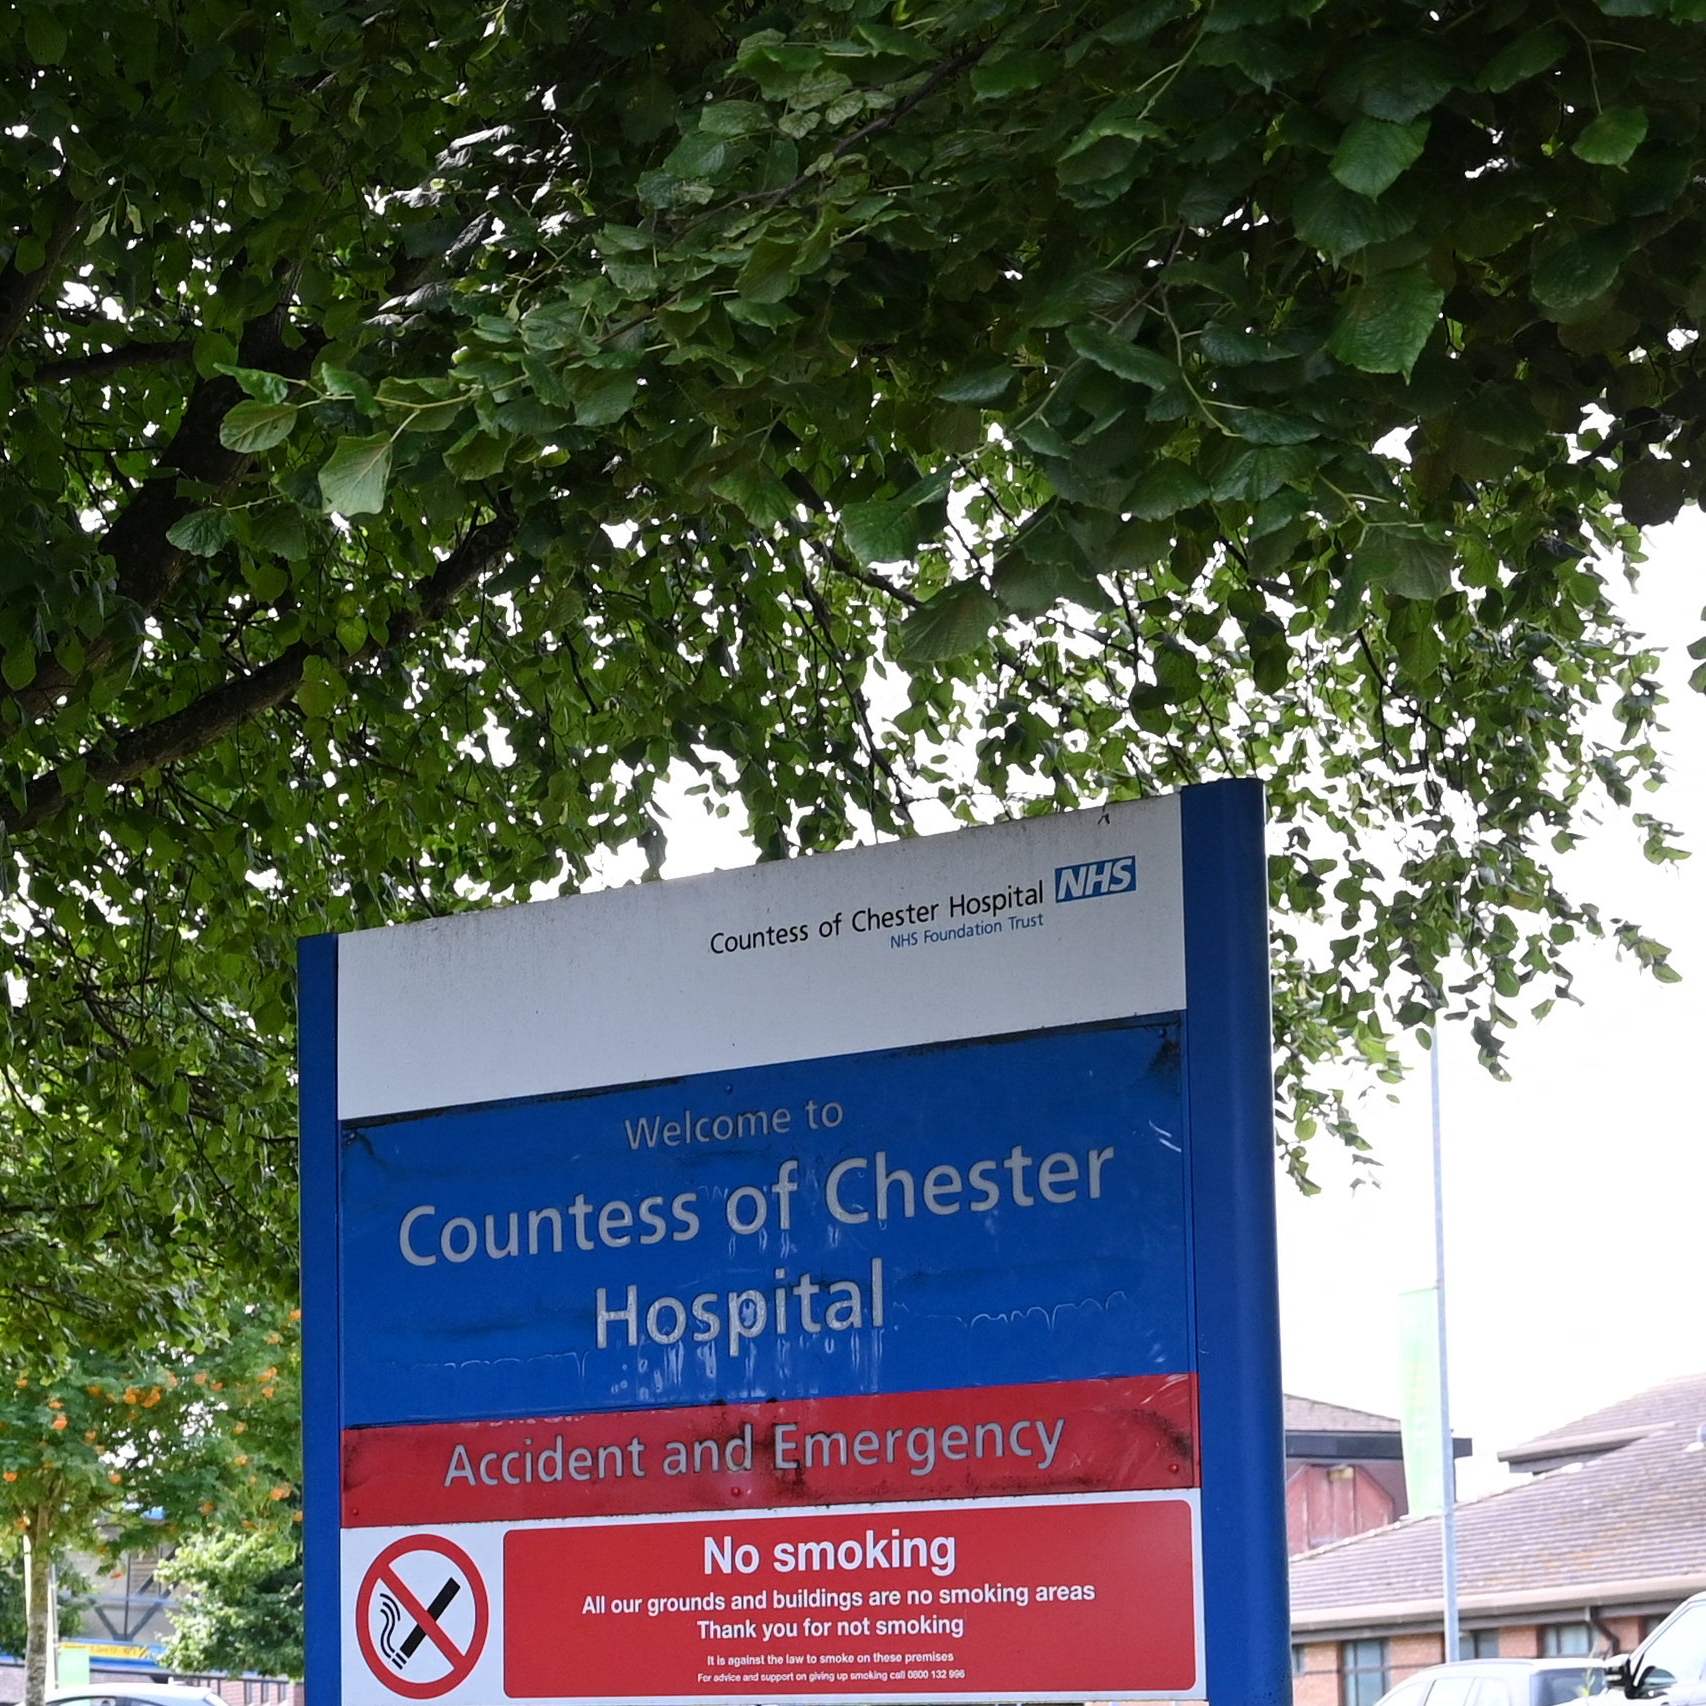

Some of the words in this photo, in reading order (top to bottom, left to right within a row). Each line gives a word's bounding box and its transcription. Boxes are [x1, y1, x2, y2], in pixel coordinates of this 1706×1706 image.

[1057, 859, 1133, 901] NHS
[711, 925, 808, 954] Countess
[818, 911, 843, 938] of
[852, 904, 939, 933] Chester
[950, 879, 1043, 919] Hospital
[891, 932, 917, 948] NHS
[923, 919, 1002, 943] Foundation
[1008, 914, 1043, 930] Trust
[625, 1109, 790, 1149] Welcome
[805, 1101, 842, 1129] to
[400, 1193, 699, 1266] Countess
[726, 1161, 797, 1234] of
[826, 1146, 1113, 1225] Chester
[597, 1258, 884, 1356] Hospital
[444, 1436, 644, 1486] Accident
[664, 1424, 751, 1475] and
[776, 1420, 1064, 1475] Emergency
[705, 1536, 759, 1574] No
[774, 1529, 955, 1575] smoking
[582, 1596, 605, 1614] All
[611, 1599, 642, 1613] our
[648, 1592, 725, 1616] grounds
[731, 1590, 766, 1609] and
[774, 1589, 862, 1611] buildings
[869, 1591, 901, 1605] are
[908, 1590, 932, 1604] no
[940, 1583, 1028, 1606] smoking
[1036, 1585, 1095, 1601] areas
[697, 1620, 756, 1639] Thank
[763, 1623, 797, 1641] you
[803, 1618, 831, 1636] for
[838, 1617, 870, 1636] not
[876, 1615, 963, 1638] smoking
[708, 1655, 714, 1665] It
[717, 1655, 725, 1665] is
[728, 1654, 764, 1667] against
[768, 1654, 783, 1664] the
[786, 1653, 804, 1664] law
[807, 1654, 817, 1663] to
[820, 1652, 854, 1663] smoke
[857, 1654, 870, 1663] on
[873, 1652, 902, 1662] these
[905, 1650, 954, 1664] premises
